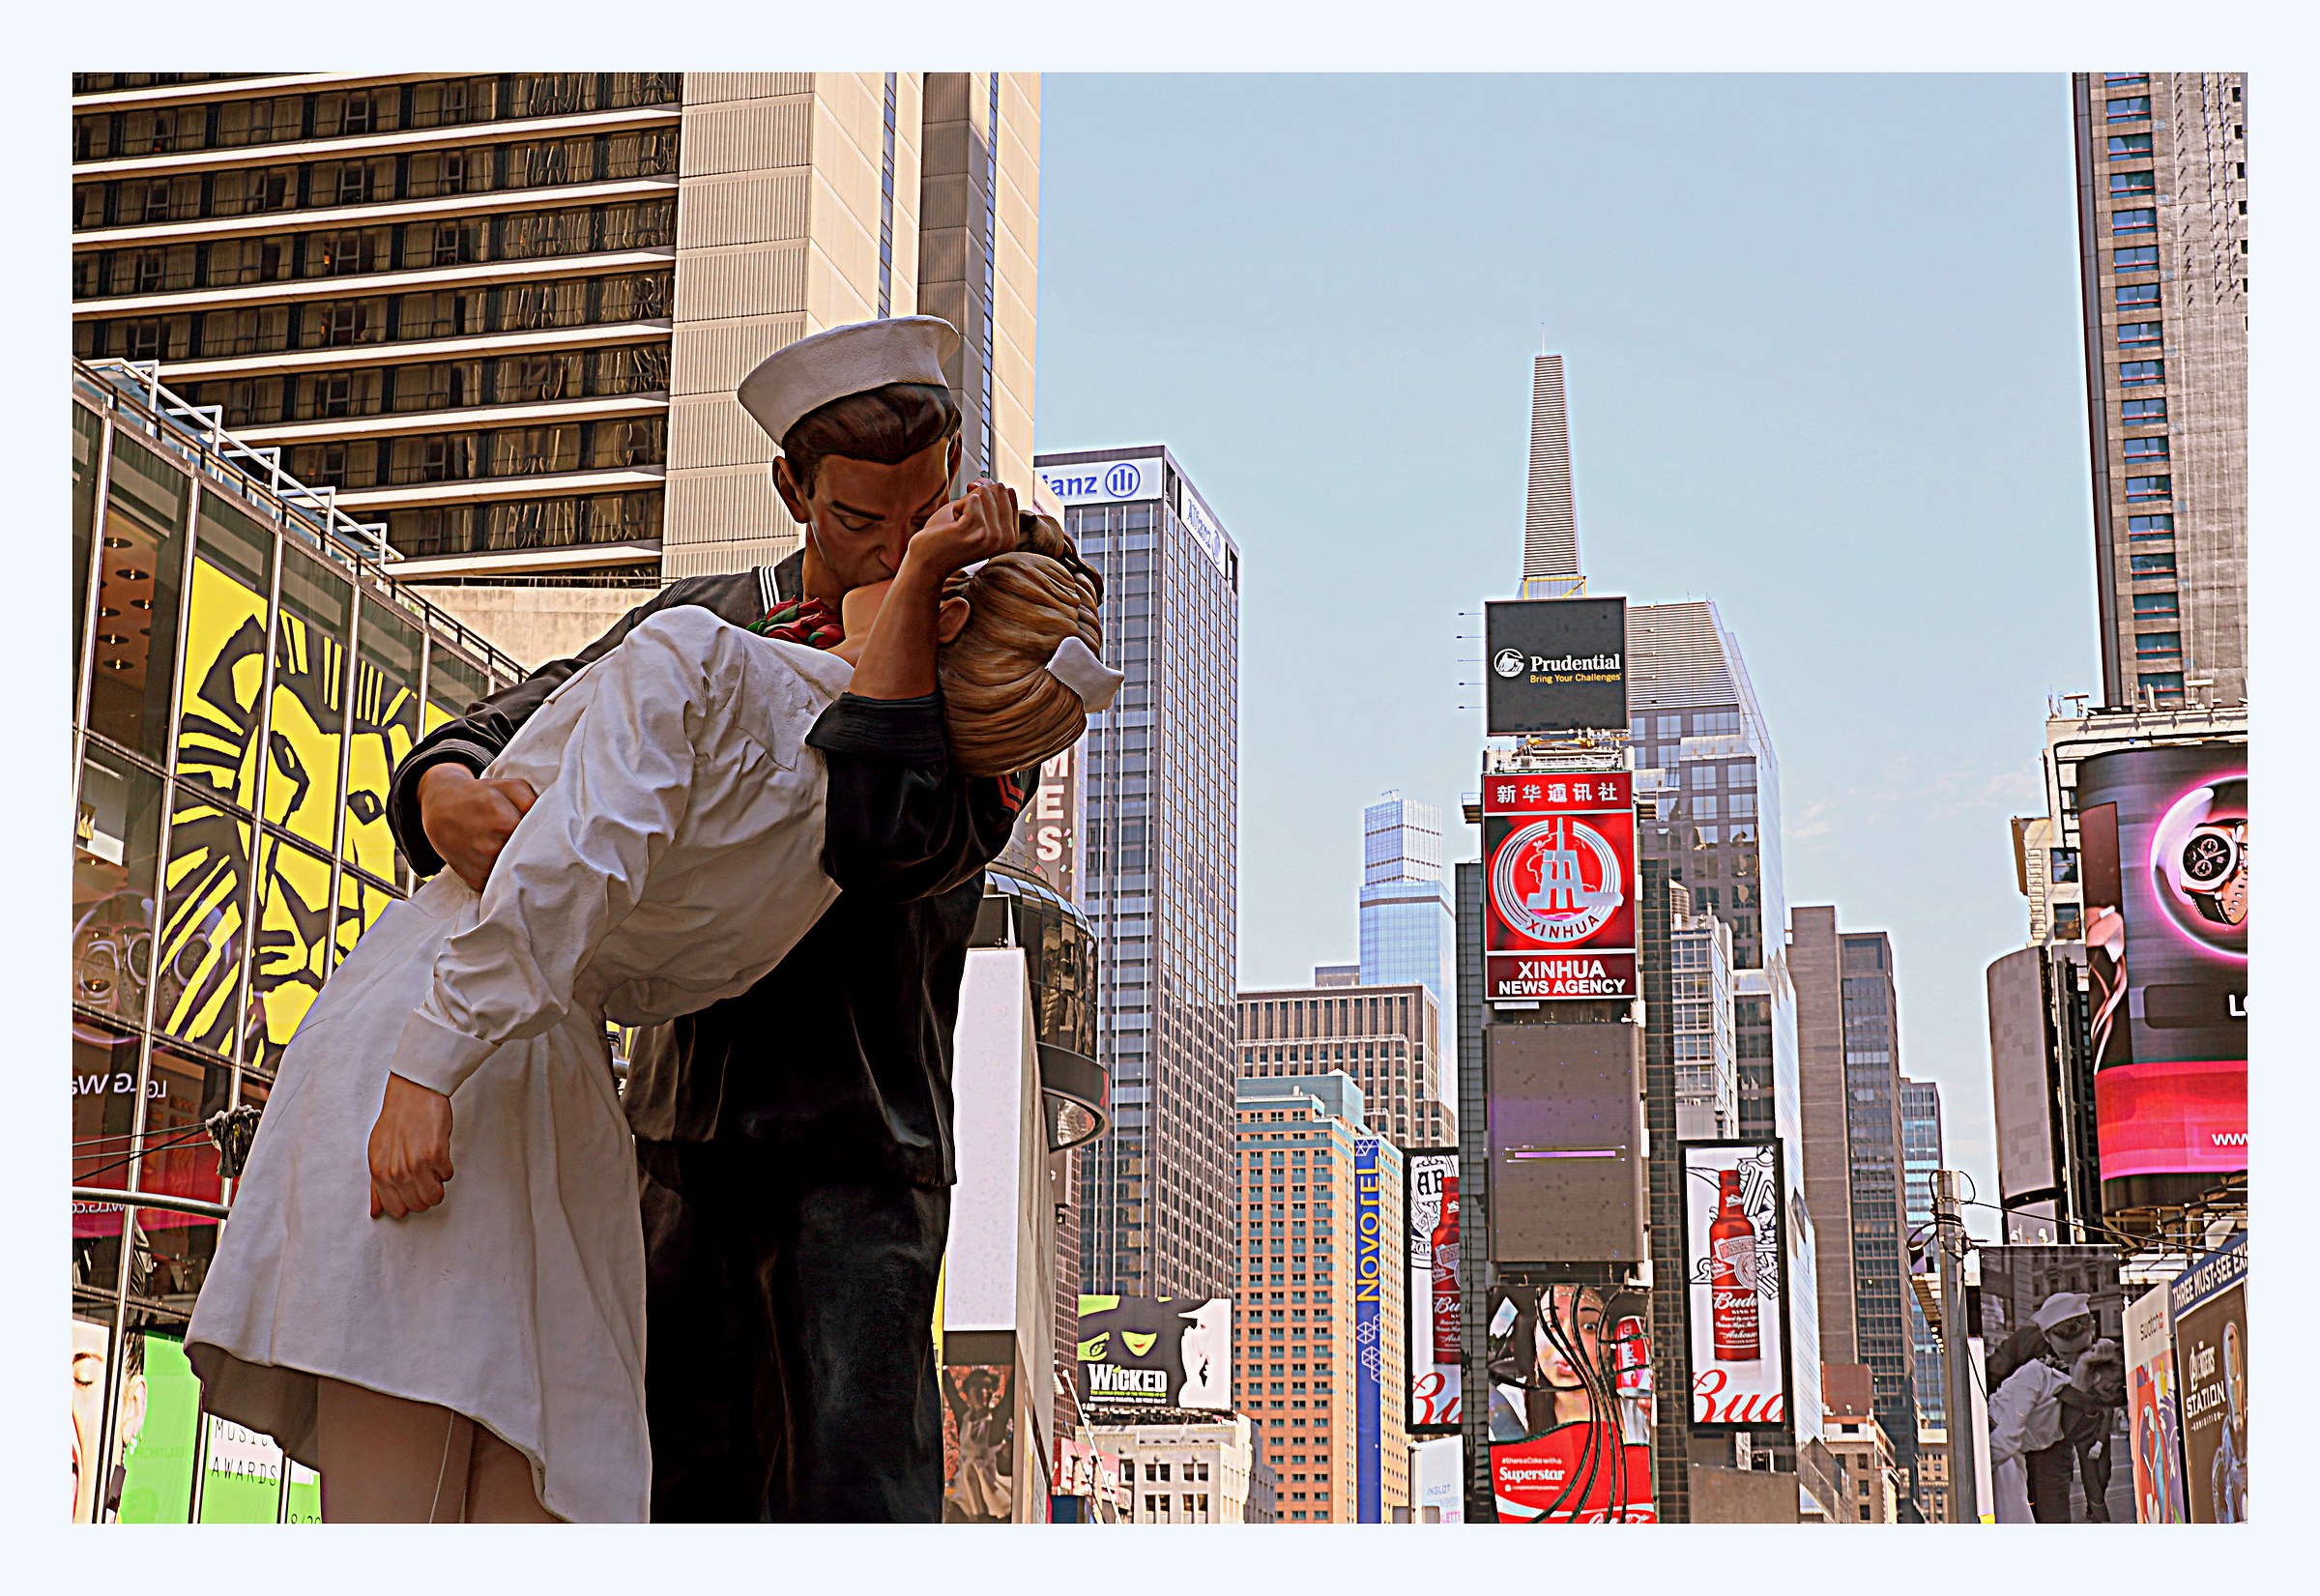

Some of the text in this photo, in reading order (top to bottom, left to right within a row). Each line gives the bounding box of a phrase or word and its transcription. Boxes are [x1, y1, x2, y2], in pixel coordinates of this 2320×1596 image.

[1530, 653, 1620, 673] Prudential
[1530, 673, 1621, 684] Bring Your Challenges
[1497, 782, 1618, 804] 新华通讯社
[1525, 914, 1600, 939] XINHUA
[1519, 960, 1607, 979] XINHUA
[1499, 978, 1626, 996] NEWS AGENCY
[1356, 1156, 1379, 1302] NOVOTEL
[2173, 1276, 2194, 1311] THREE
[2193, 1253, 2232, 1297] MUST-SEE
[2186, 1379, 2226, 1419] STATION
[211, 1456, 277, 1487] AWARDS
[1499, 1465, 1565, 1484] Superstar
